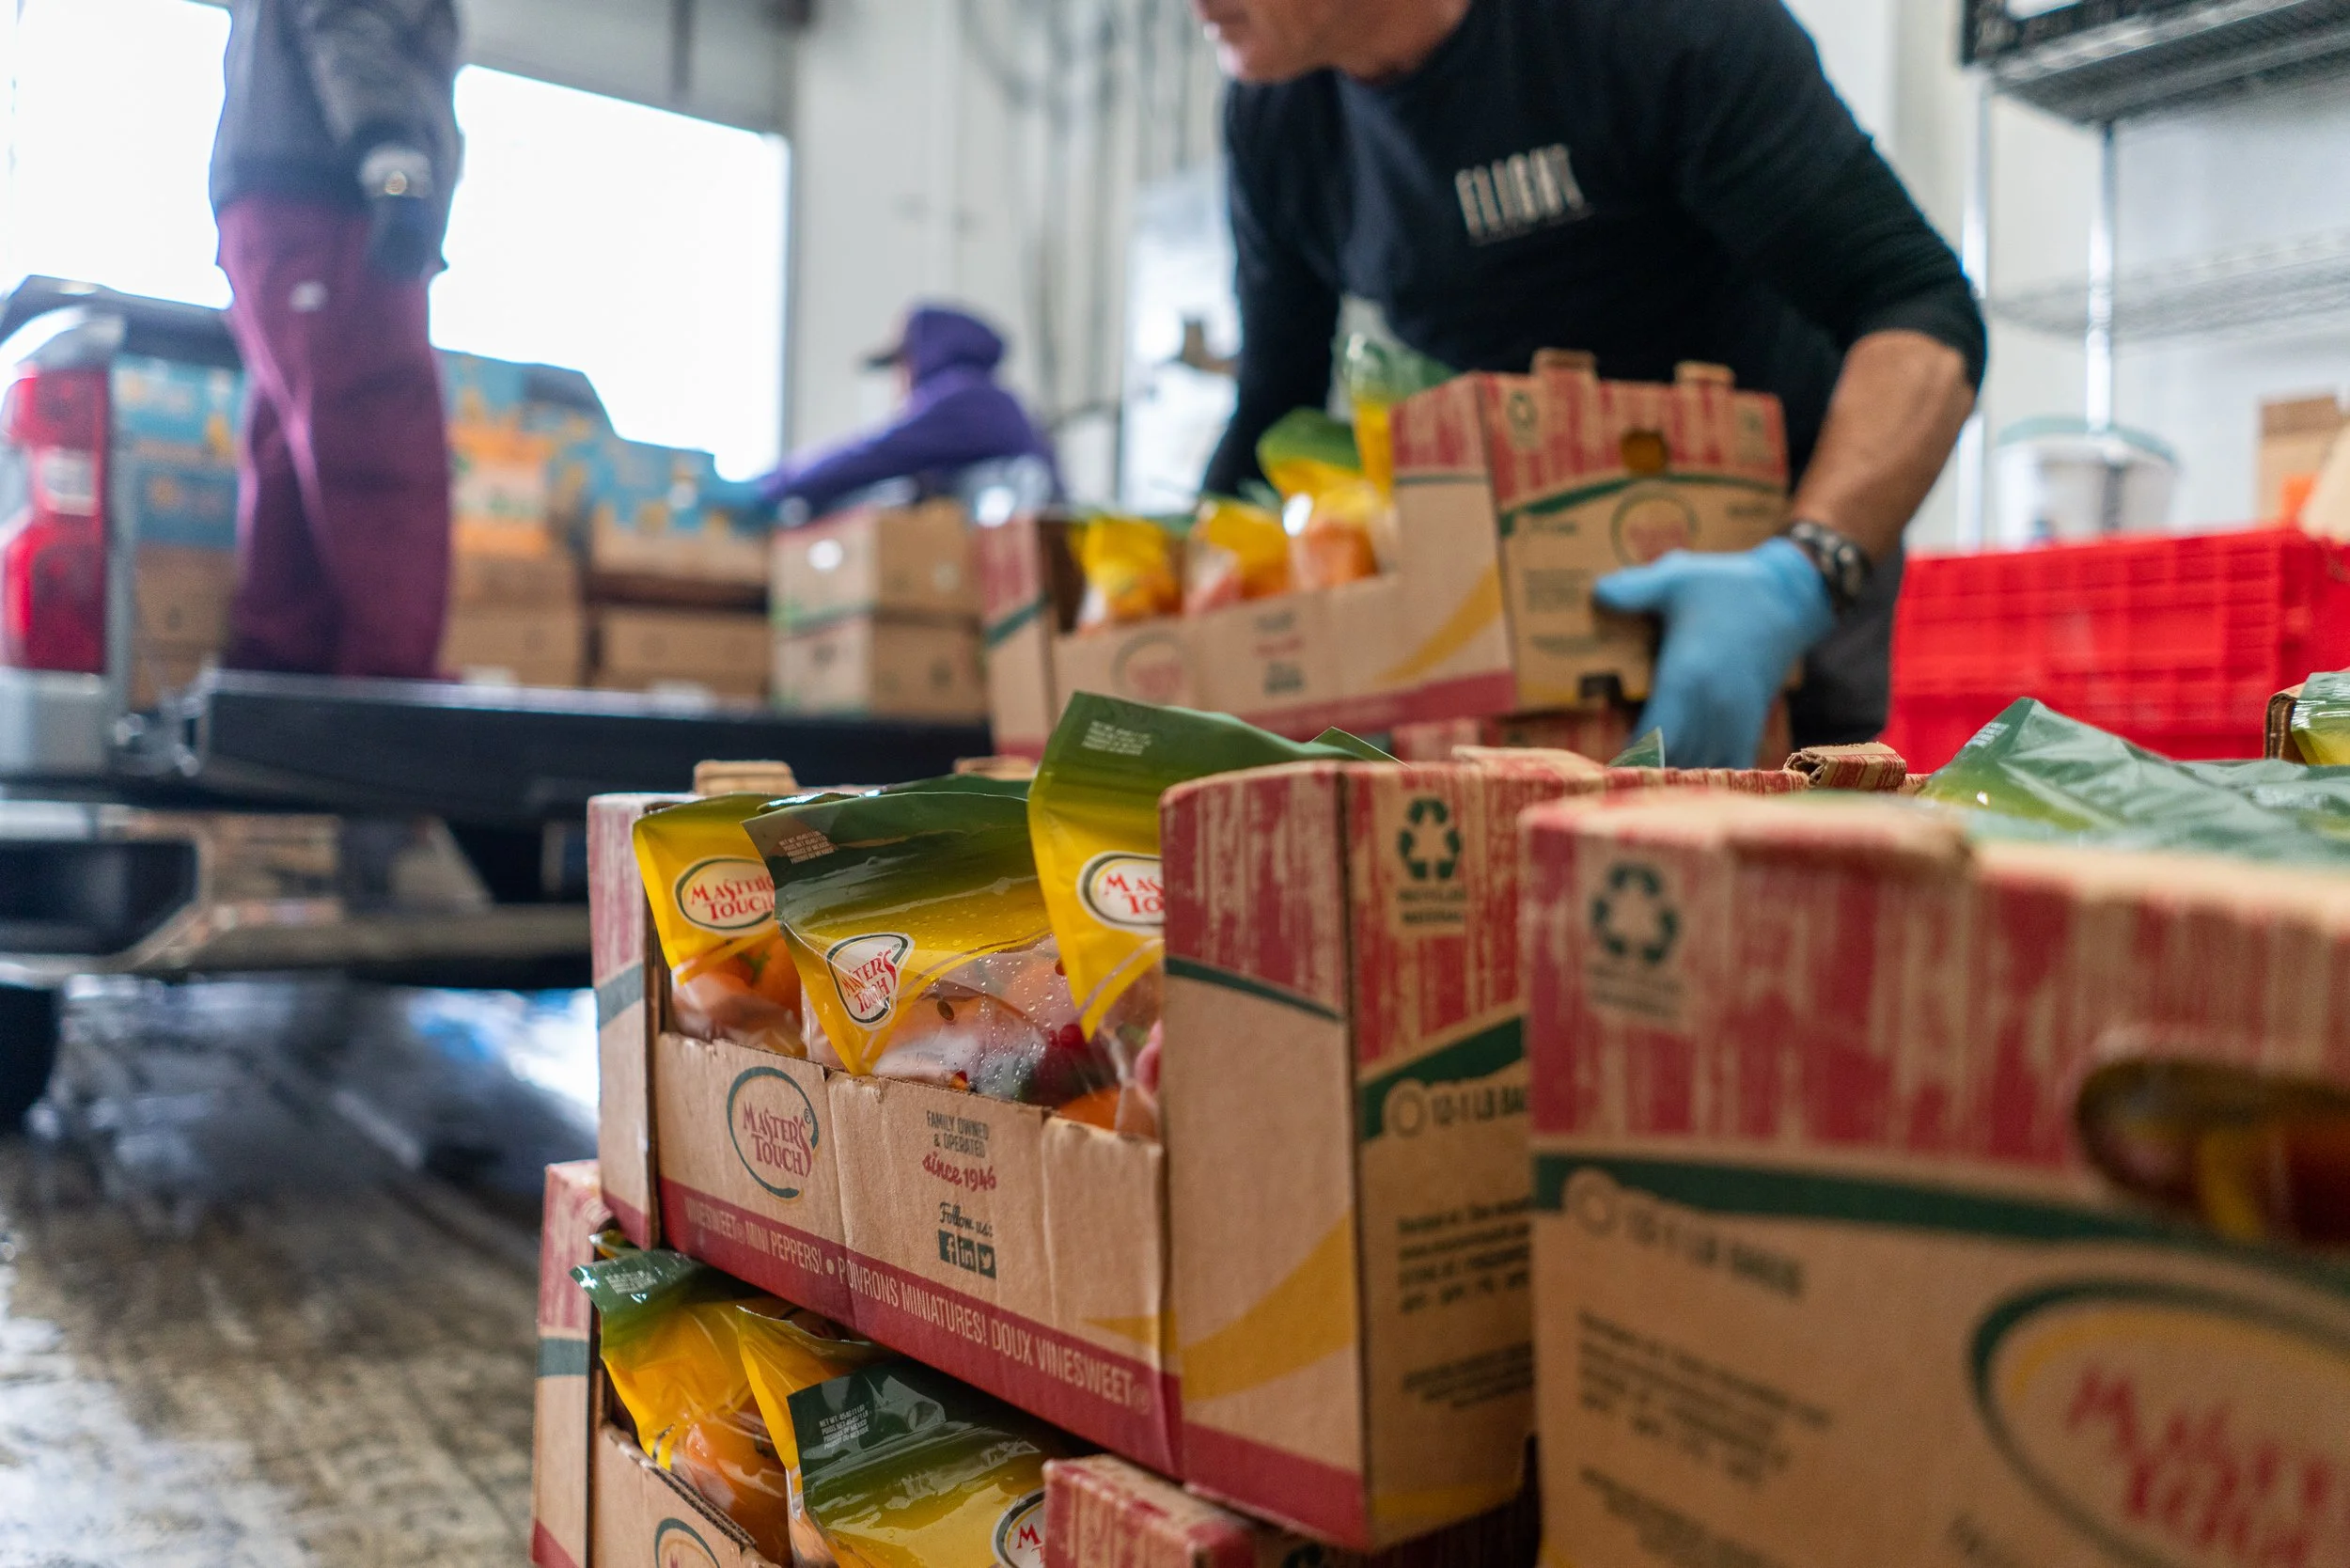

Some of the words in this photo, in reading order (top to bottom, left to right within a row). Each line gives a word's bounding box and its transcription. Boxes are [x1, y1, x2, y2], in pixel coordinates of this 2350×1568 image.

[926, 1110, 955, 1134] FAMILY
[957, 1118, 989, 1140] OWNED
[750, 1130, 806, 1178] TOUCH
[933, 1133, 940, 1148] &
[944, 1133, 986, 1158] OPERATED
[922, 1151, 963, 1186] since
[964, 1166, 996, 1192] 1946
[939, 1201, 974, 1231] Follow
[770, 1231, 824, 1276] PEPPERS!
[838, 1256, 899, 1308] POIVRONS
[901, 1282, 988, 1346] MINIATURES!
[991, 1318, 1034, 1366] DOUX
